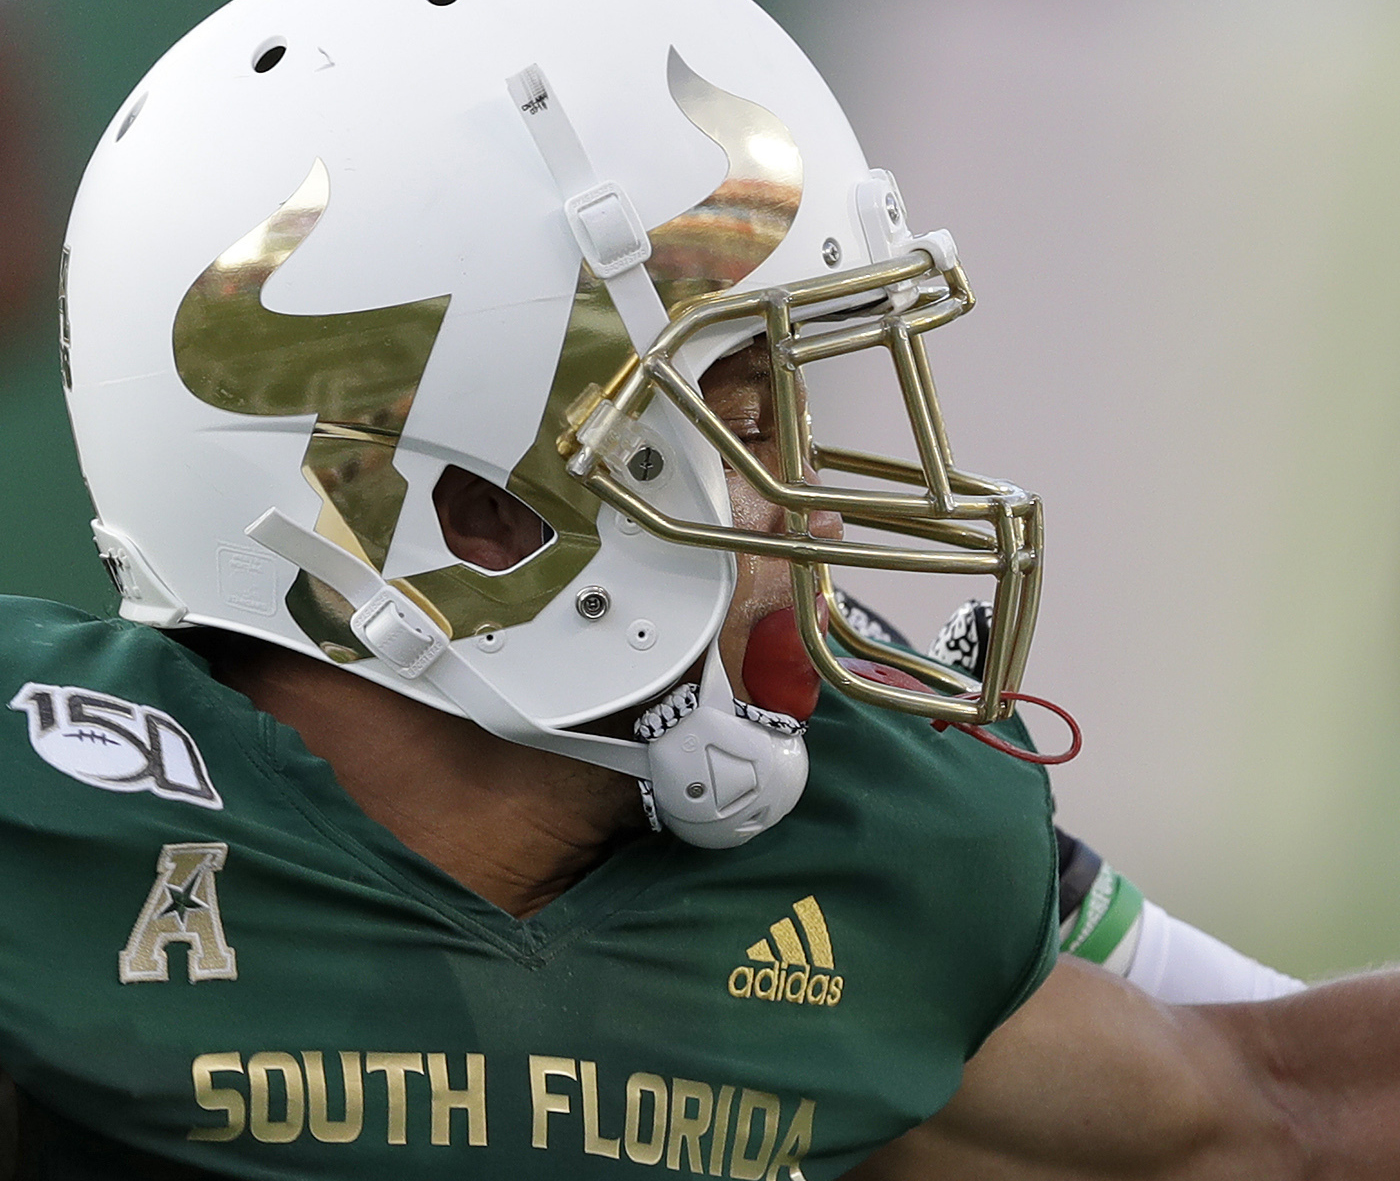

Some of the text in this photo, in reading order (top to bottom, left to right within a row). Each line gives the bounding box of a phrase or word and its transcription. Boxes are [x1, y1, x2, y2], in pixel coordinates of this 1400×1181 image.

[20, 686, 220, 806] 150
[118, 841, 239, 985] A
[728, 960, 844, 1008] adidas
[186, 1050, 488, 1147] SOUTH
